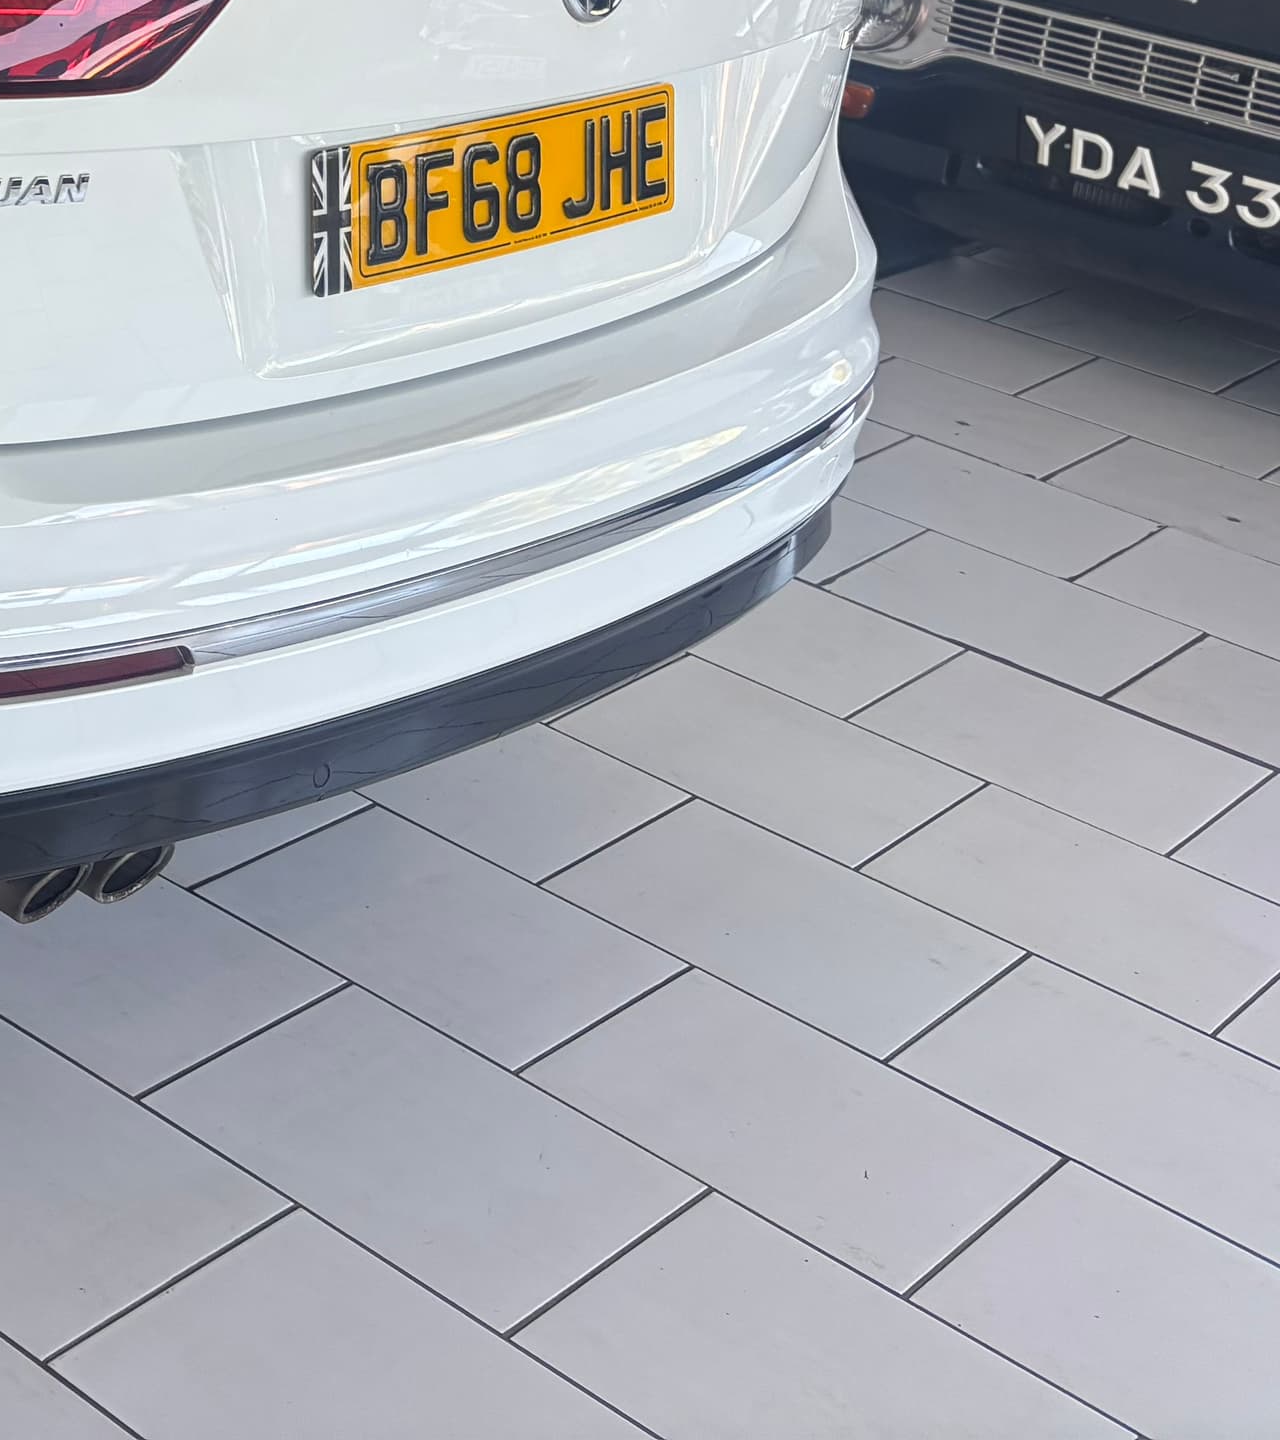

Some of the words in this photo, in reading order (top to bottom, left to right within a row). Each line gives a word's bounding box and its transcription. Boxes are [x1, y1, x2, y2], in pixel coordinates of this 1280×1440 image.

[367, 132, 542, 267] BF68
[562, 103, 668, 221] JHE
[1024, 114, 1161, 199] YDA
